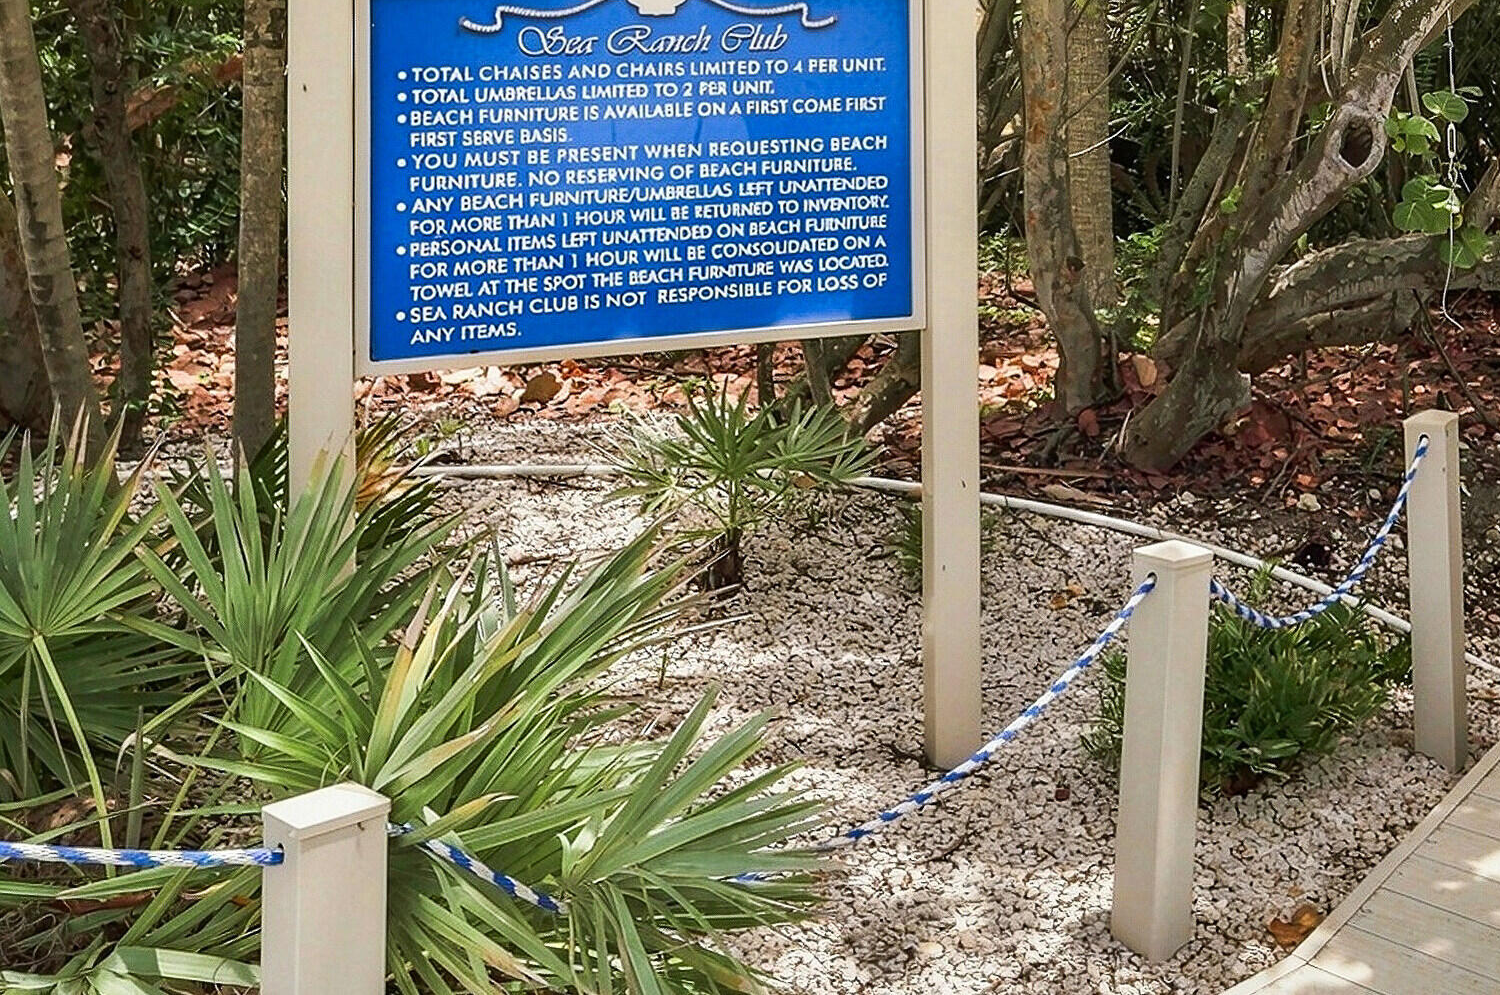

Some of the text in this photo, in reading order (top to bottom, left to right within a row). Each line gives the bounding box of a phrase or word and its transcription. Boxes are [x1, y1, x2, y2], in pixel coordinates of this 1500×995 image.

[518, 24, 787, 54] Sea Ranch Club
[412, 58, 885, 82] TOTAL CHAISES AND CHAIRS LIMITED TO 4 PER UNIT.
[413, 80, 774, 104] TOTAL UMBRELLAS LIMITED TO 2 PER UNIT.
[411, 97, 885, 125] BEACH FURNITURE IS AVAILABLE ON A FIRST COME FIRST
[411, 128, 572, 147] FIRST SERVE BASIS.
[412, 136, 886, 169] YOU MUST BE PRESENT WHEN REQUESTING BEACH
[411, 157, 856, 191] FURNITURE. NO RESERVING OF BEACH FURNITURE.
[412, 176, 888, 213] ANY BEACH FURNITURE/UMBRELLAS LEFT UNATTENDED
[411, 219, 447, 235] FOR
[451, 216, 502, 233] MORE
[508, 214, 555, 230] THAN
[575, 209, 626, 226] HOUR
[630, 208, 666, 224] WILL
[672, 206, 689, 220] BE
[695, 202, 774, 219] RETURNED
[778, 200, 798, 213] TO
[804, 195, 888, 212] INVENTORY.
[411, 215, 886, 256] PERSONAL ITEMS LEFT UNATTENDED ON BEACH FURNITURE
[411, 263, 447, 279] FOR
[454, 259, 507, 275] MORE
[513, 256, 563, 272] THAN
[587, 251, 638, 266] HOUR
[644, 248, 681, 261] WILL
[688, 245, 705, 260] BE
[844, 236, 869, 249] ON
[875, 236, 886, 247] A
[411, 254, 888, 301] TOWEL AT THE SPOT THE BEACH FURNITURE WAS LOCATED.
[411, 273, 886, 322] SEA RANCH CLUB IS NOT RESPONSIBLE FOR LOSS OF
[411, 323, 521, 344] ANY ITEMS.
